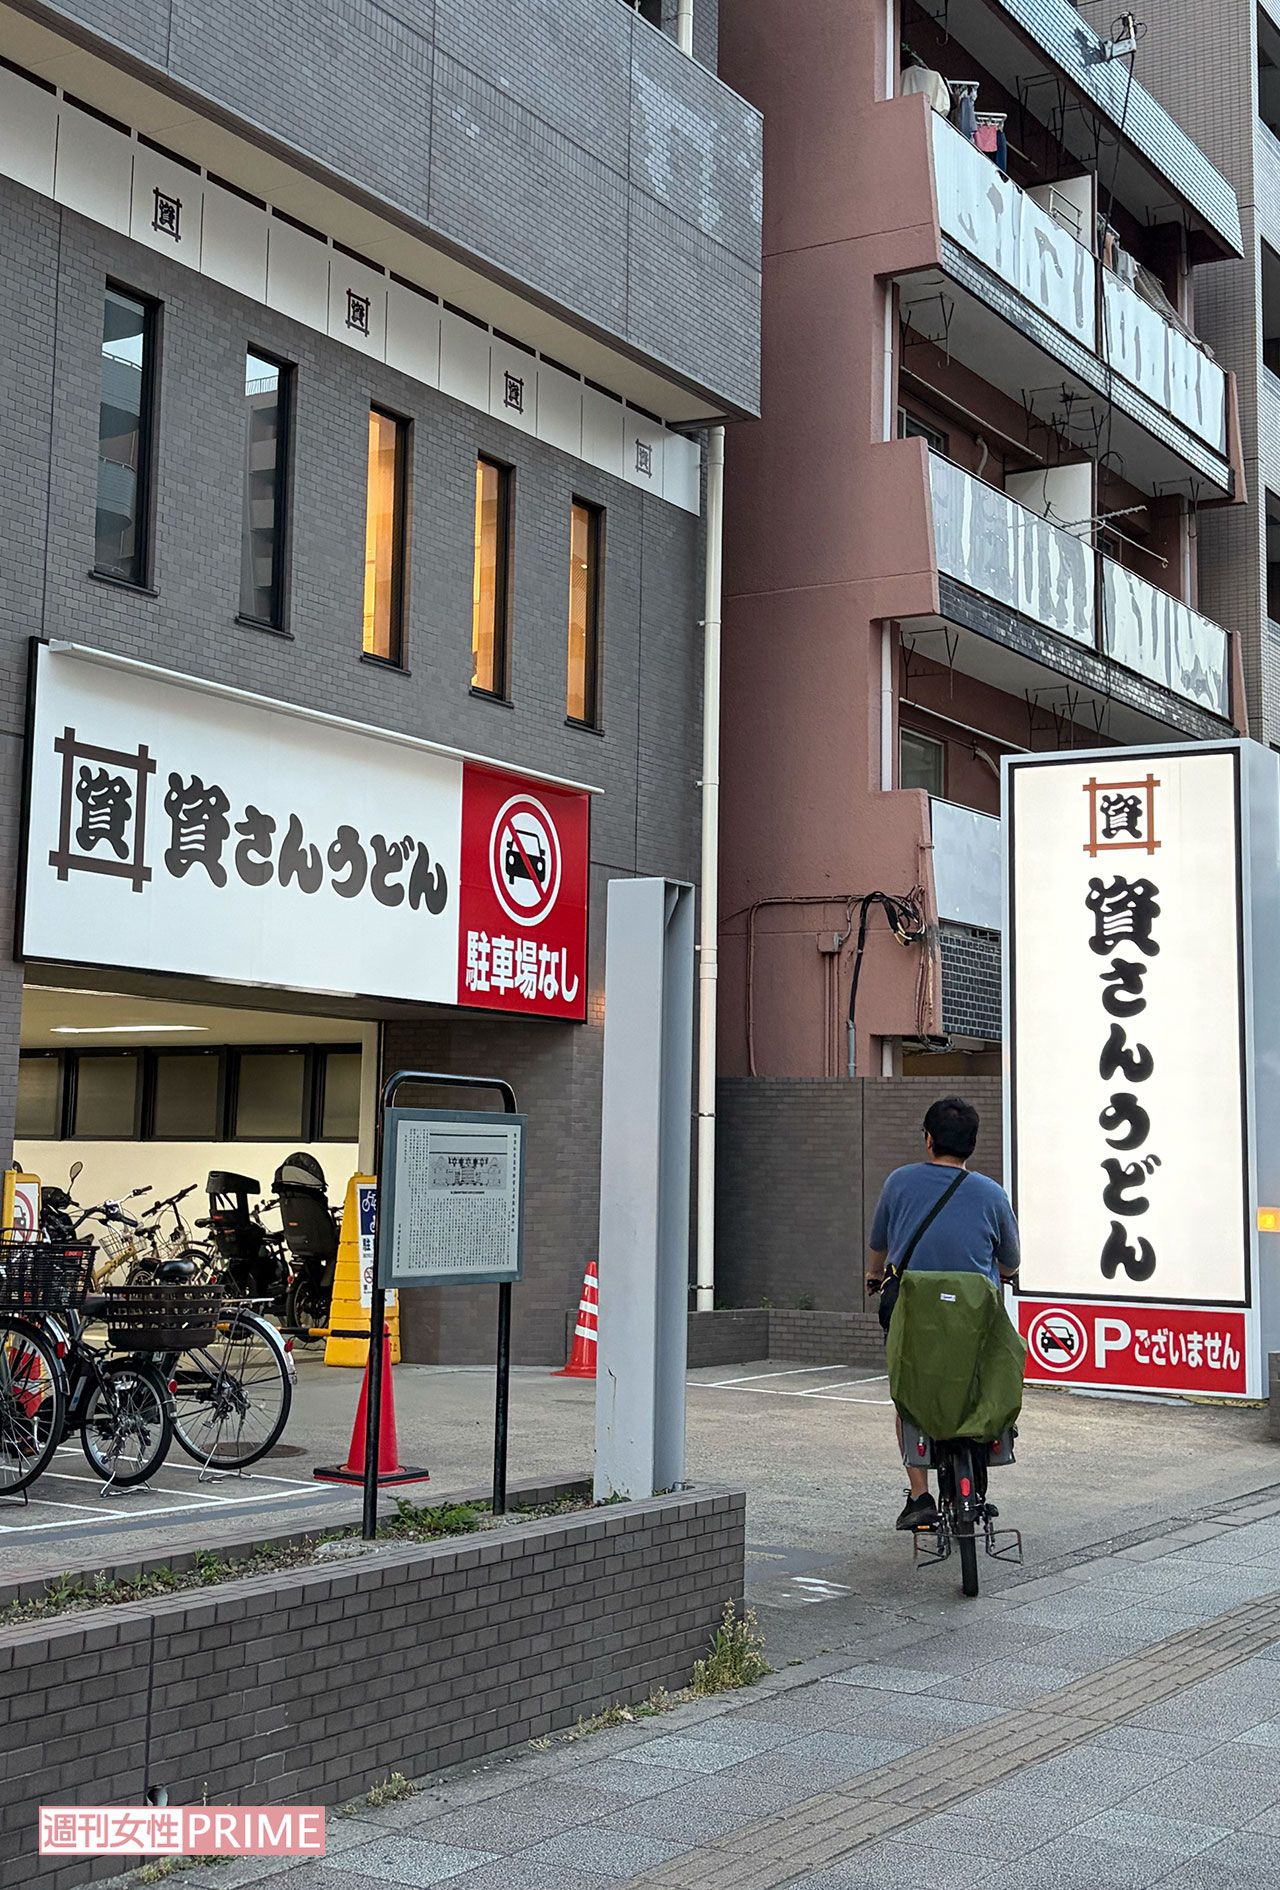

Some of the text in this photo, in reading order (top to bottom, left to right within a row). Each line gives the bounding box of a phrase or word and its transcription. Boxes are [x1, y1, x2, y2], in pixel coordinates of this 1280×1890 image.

[164, 772, 447, 915] 資さんうどん
[465, 930, 579, 1002] 駐車場なし
[1085, 875, 1161, 1282] 資さんうどん
